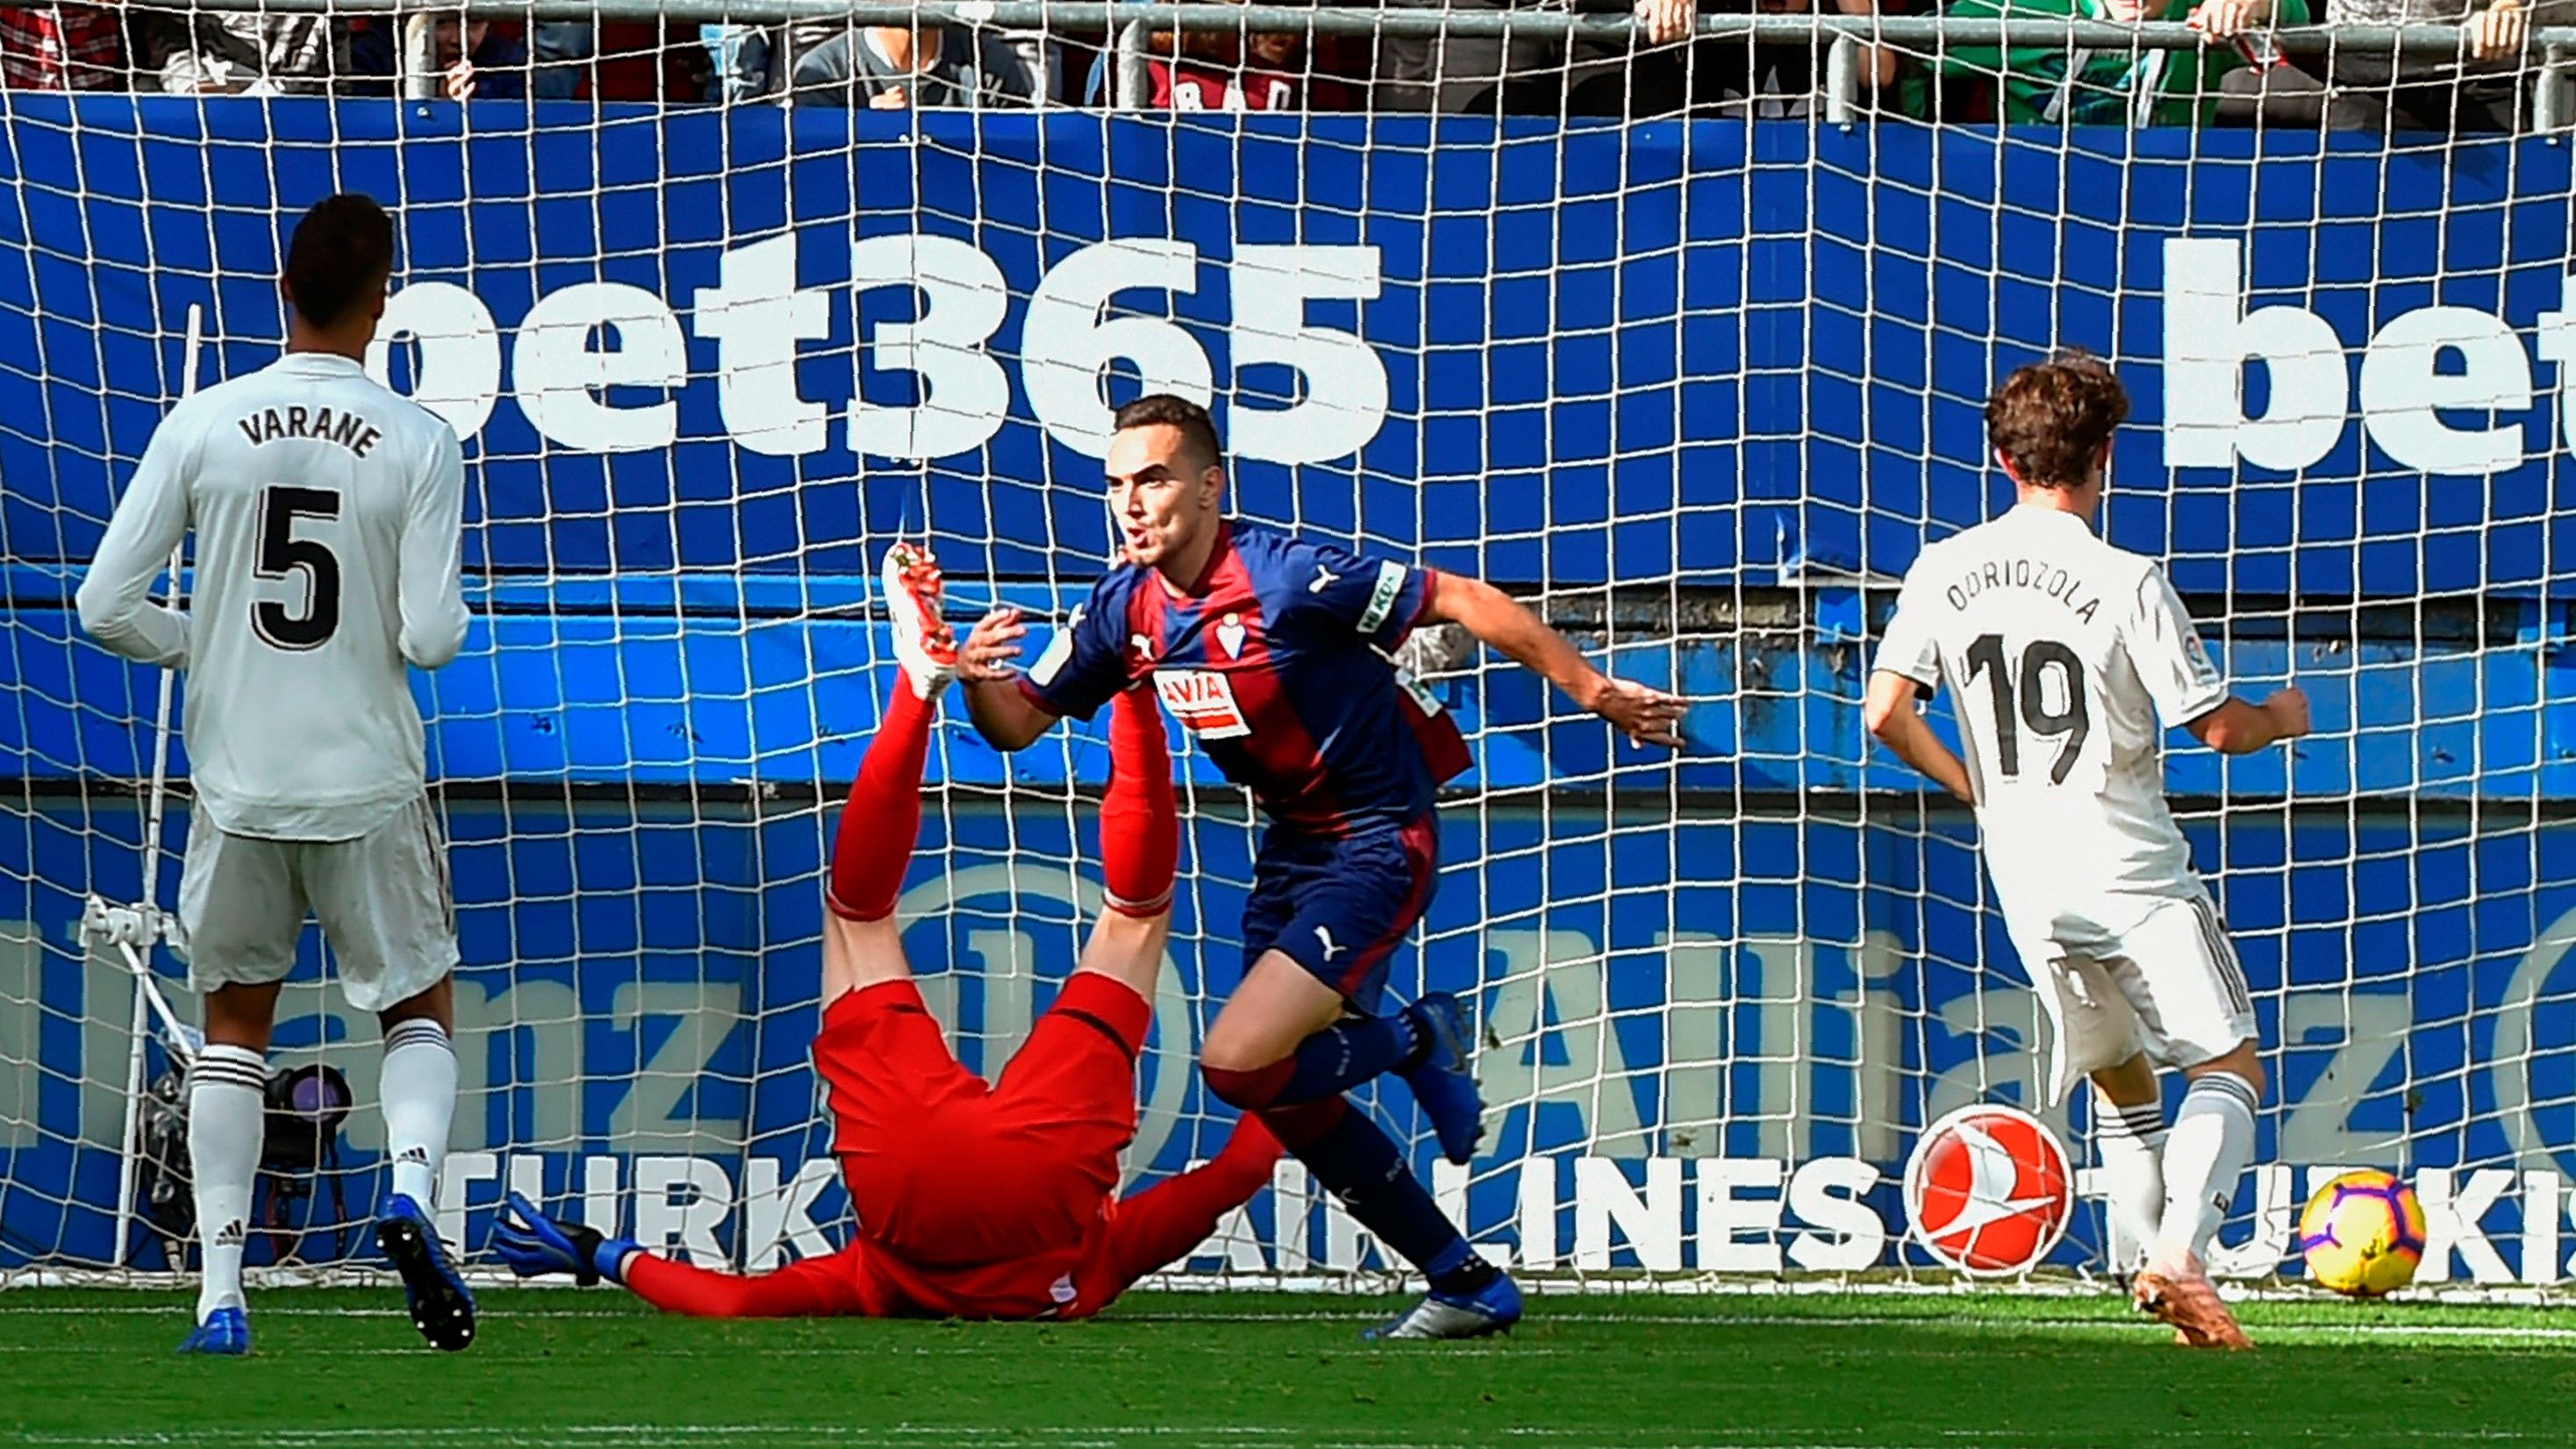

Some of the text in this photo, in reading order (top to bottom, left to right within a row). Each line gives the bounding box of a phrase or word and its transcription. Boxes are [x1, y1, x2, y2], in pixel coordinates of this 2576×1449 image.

[239, 406, 382, 459] VARANE
[2164, 238, 2576, 475] be
[249, 485, 340, 652] 5
[1163, 675, 1225, 703] AVIA
[1959, 633, 2091, 786] 19
[1478, 930, 2413, 1167] Alliaz
[436, 1153, 841, 1274] TURK
